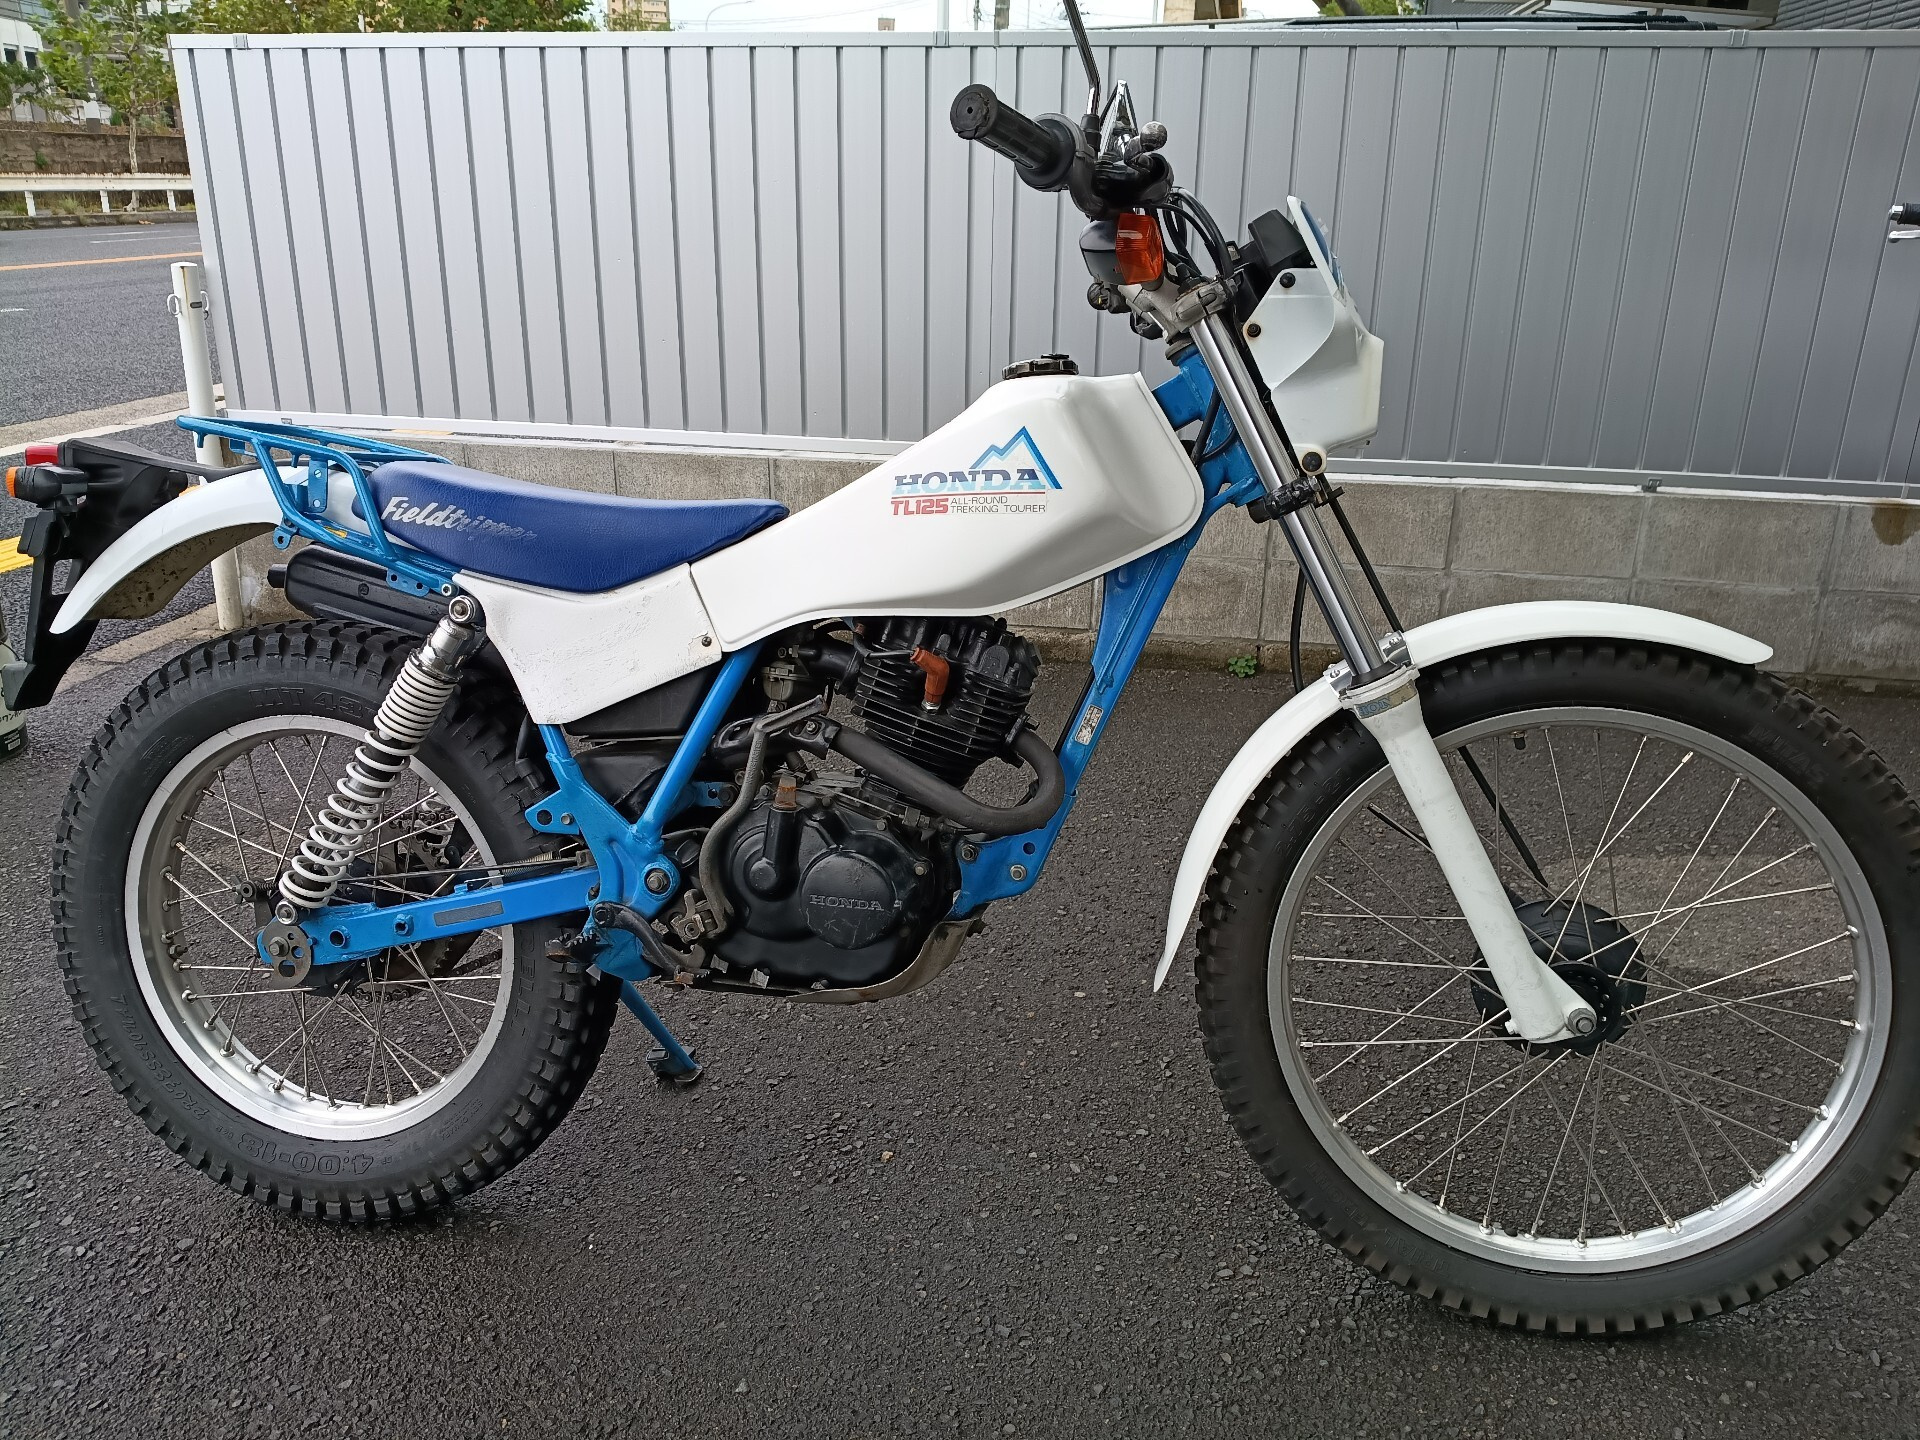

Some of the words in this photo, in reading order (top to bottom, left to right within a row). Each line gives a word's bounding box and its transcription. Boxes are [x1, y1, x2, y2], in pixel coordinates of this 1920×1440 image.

[892, 468, 1046, 494] HONDA
[890, 497, 949, 516] TL125
[950, 495, 1008, 505] ALL-ROUND
[950, 504, 999, 513] TREKKING
[1004, 504, 1046, 513] TOURER
[809, 894, 885, 911] HONDA
[109, 993, 211, 1121] PROFESSIONAL
